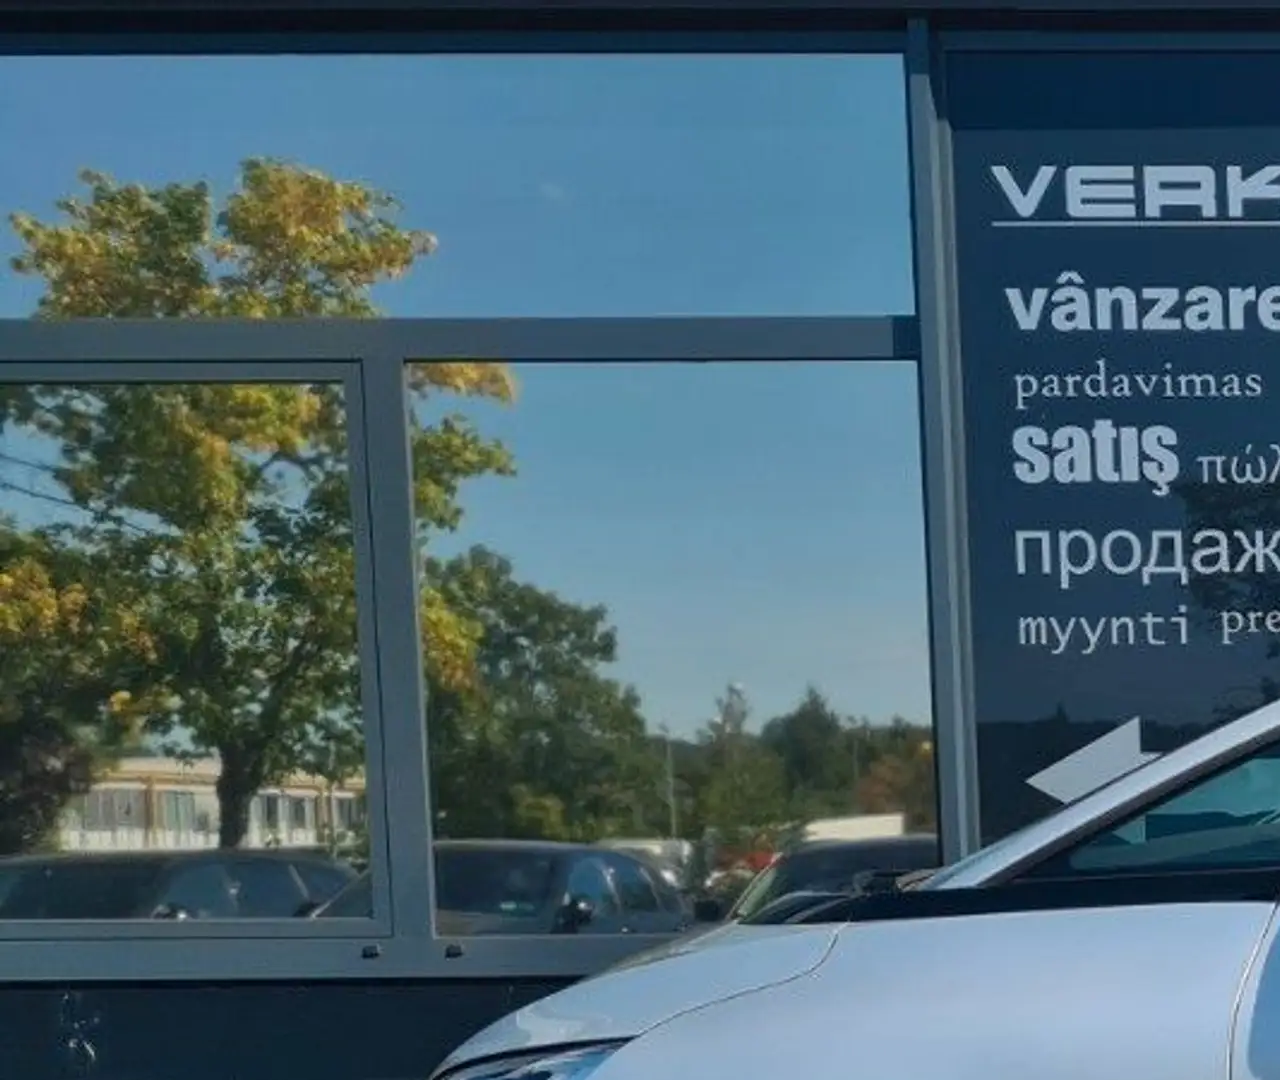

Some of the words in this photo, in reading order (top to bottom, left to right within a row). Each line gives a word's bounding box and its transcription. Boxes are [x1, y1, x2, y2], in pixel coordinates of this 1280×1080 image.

[1014, 358, 1262, 410] pardavimas
[1012, 419, 1180, 497] satış
[1019, 604, 1188, 655] myynti
